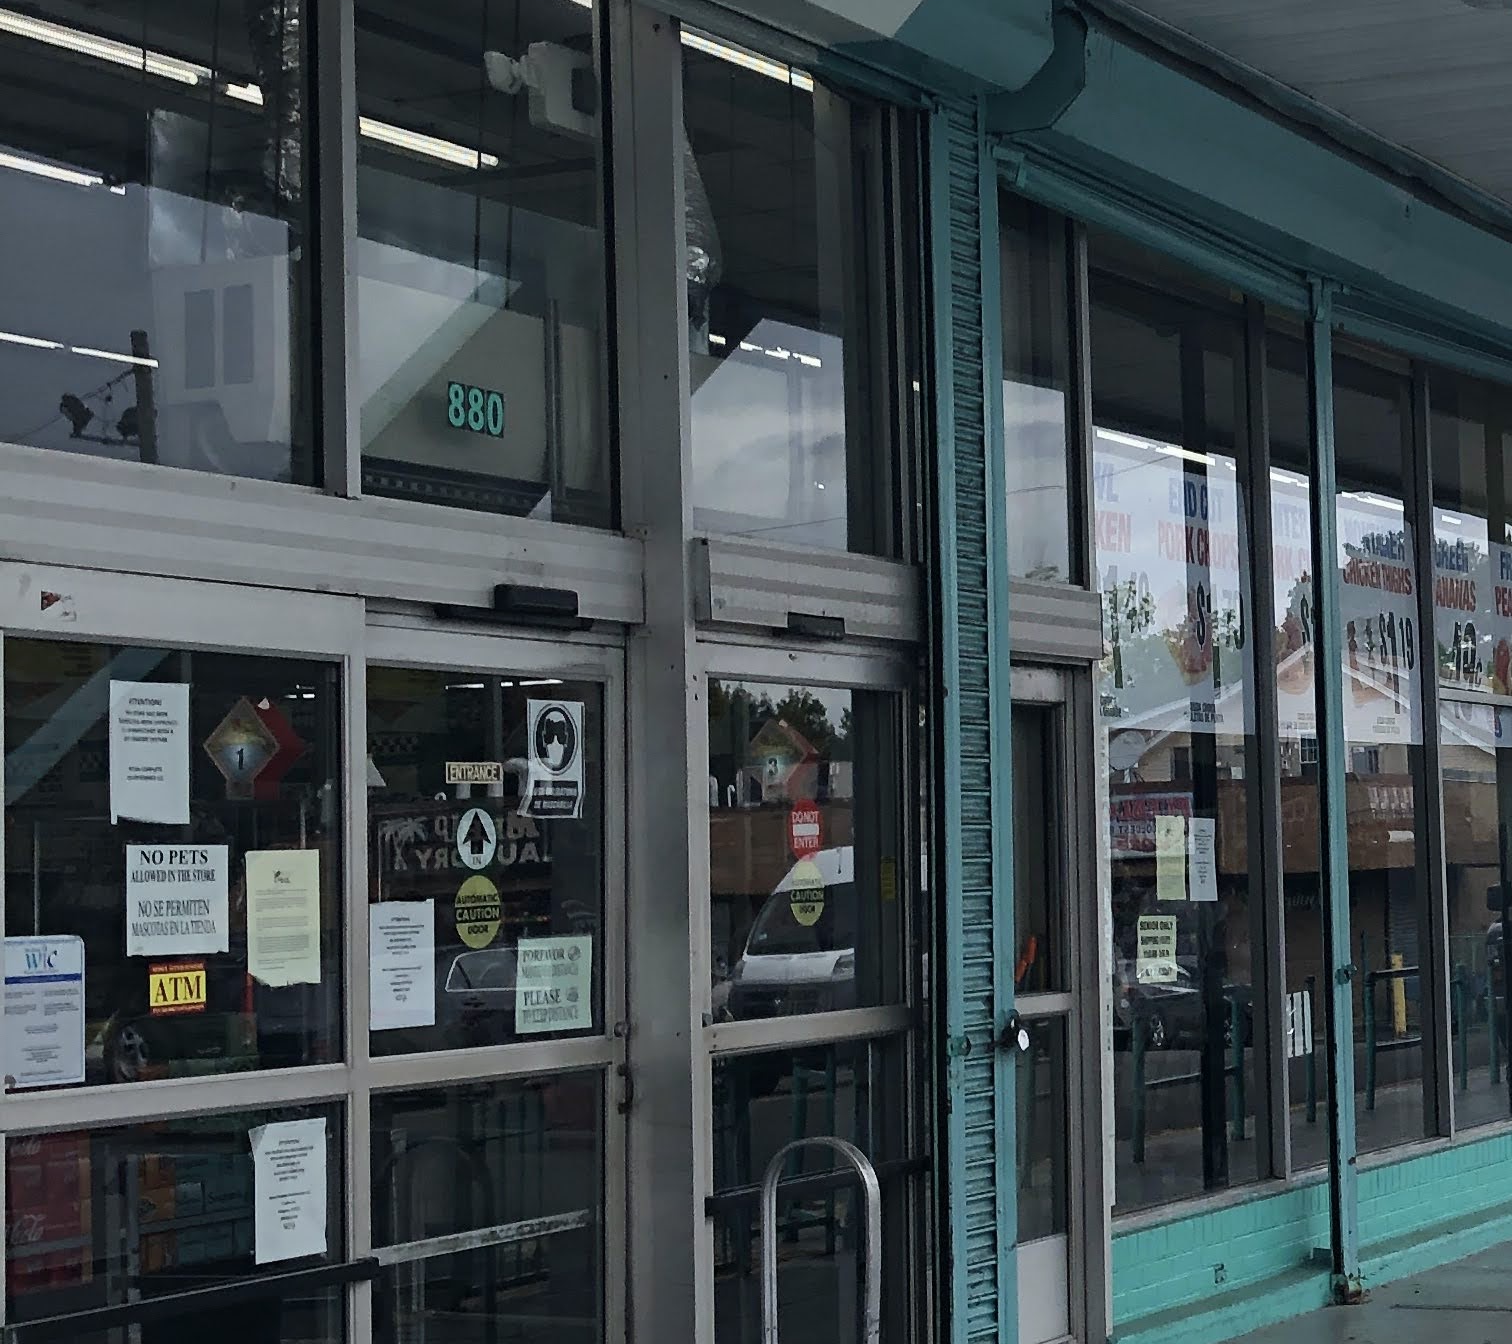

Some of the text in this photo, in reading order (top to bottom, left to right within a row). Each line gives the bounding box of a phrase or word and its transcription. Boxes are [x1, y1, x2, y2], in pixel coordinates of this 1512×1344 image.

[448, 383, 503, 436] 880
[1435, 576, 1476, 612] ANANAS
[449, 763, 498, 781] ENTRANCE
[794, 837, 819, 848] ENTER
[140, 849, 208, 865] NO PETS
[472, 856, 482, 865] IN
[131, 869, 215, 883] ALLOWED IN THE STORE
[456, 893, 498, 904] AUTOMATIC
[791, 889, 824, 903] CAUTION
[138, 899, 210, 917] NO SE PERMITEN
[455, 907, 500, 922] CAUTION
[131, 920, 168, 935] MASCOTAS
[180, 920, 189, 933] LA
[190, 919, 216, 933] TIENDA
[154, 974, 201, 1002] ATM
[523, 988, 561, 1006] PLEASE
